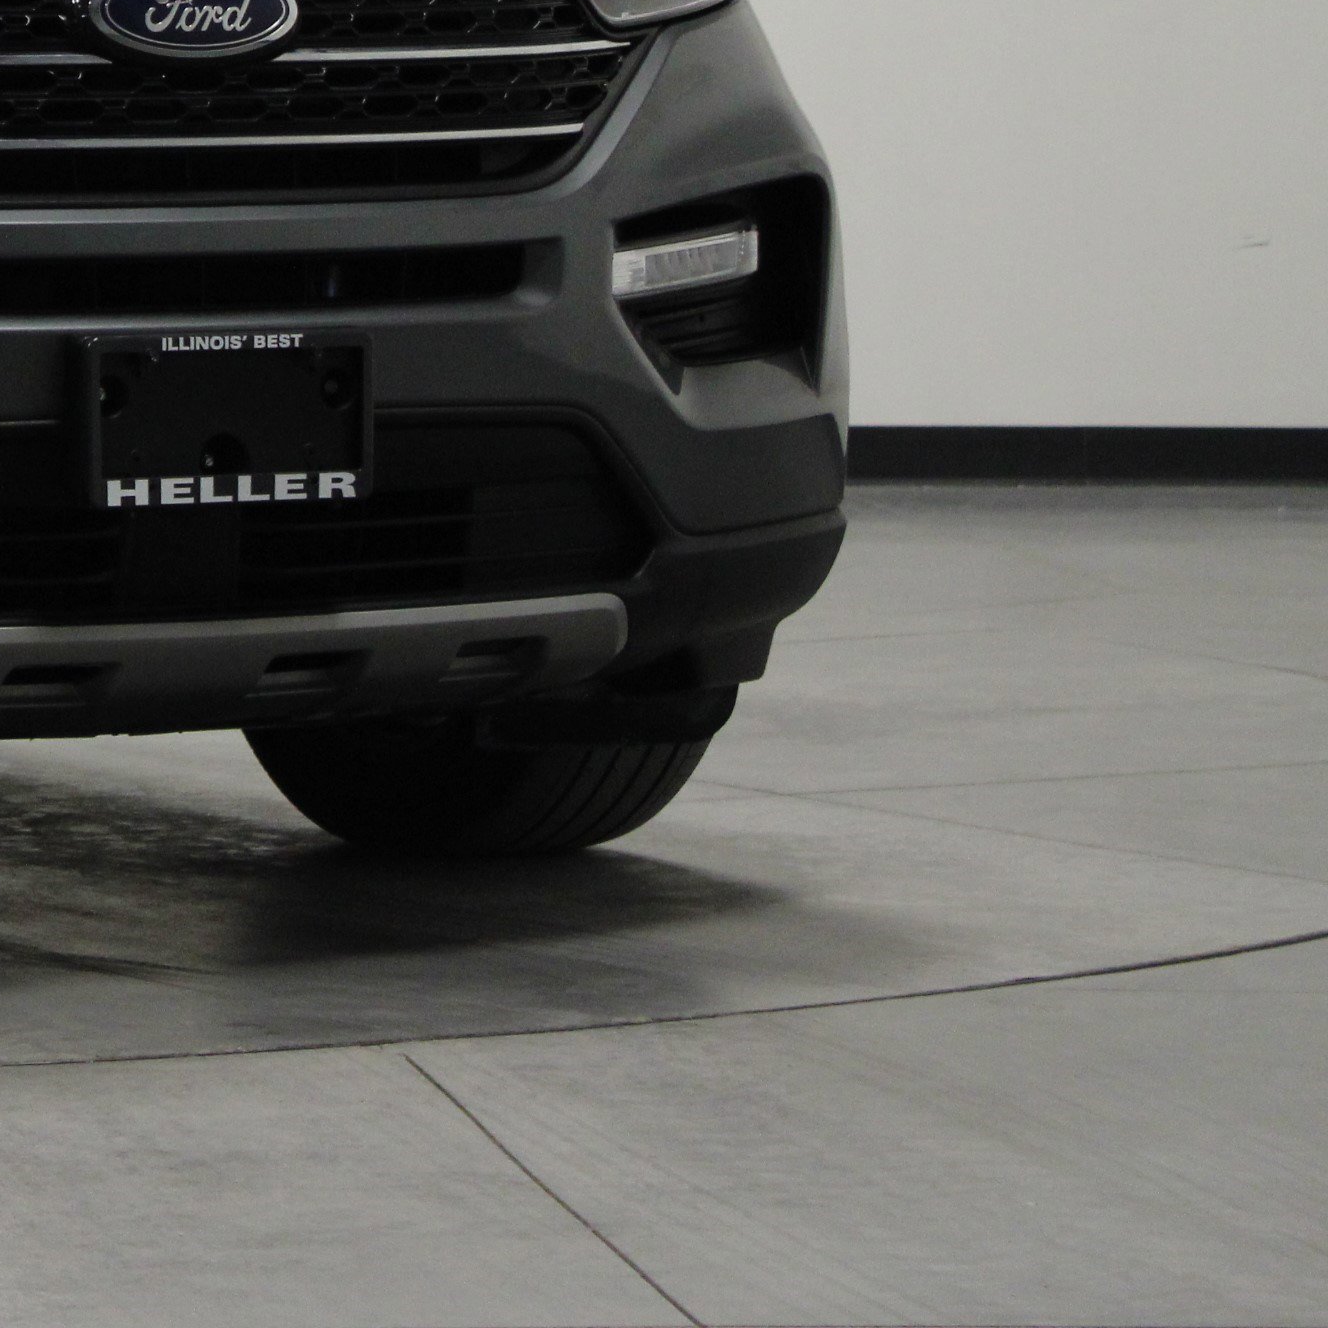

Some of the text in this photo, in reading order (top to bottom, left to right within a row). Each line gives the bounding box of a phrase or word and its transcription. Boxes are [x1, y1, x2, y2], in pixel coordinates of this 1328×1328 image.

[161, 333, 304, 351] ILLINOIS' BEST
[106, 471, 357, 507] HELLER
